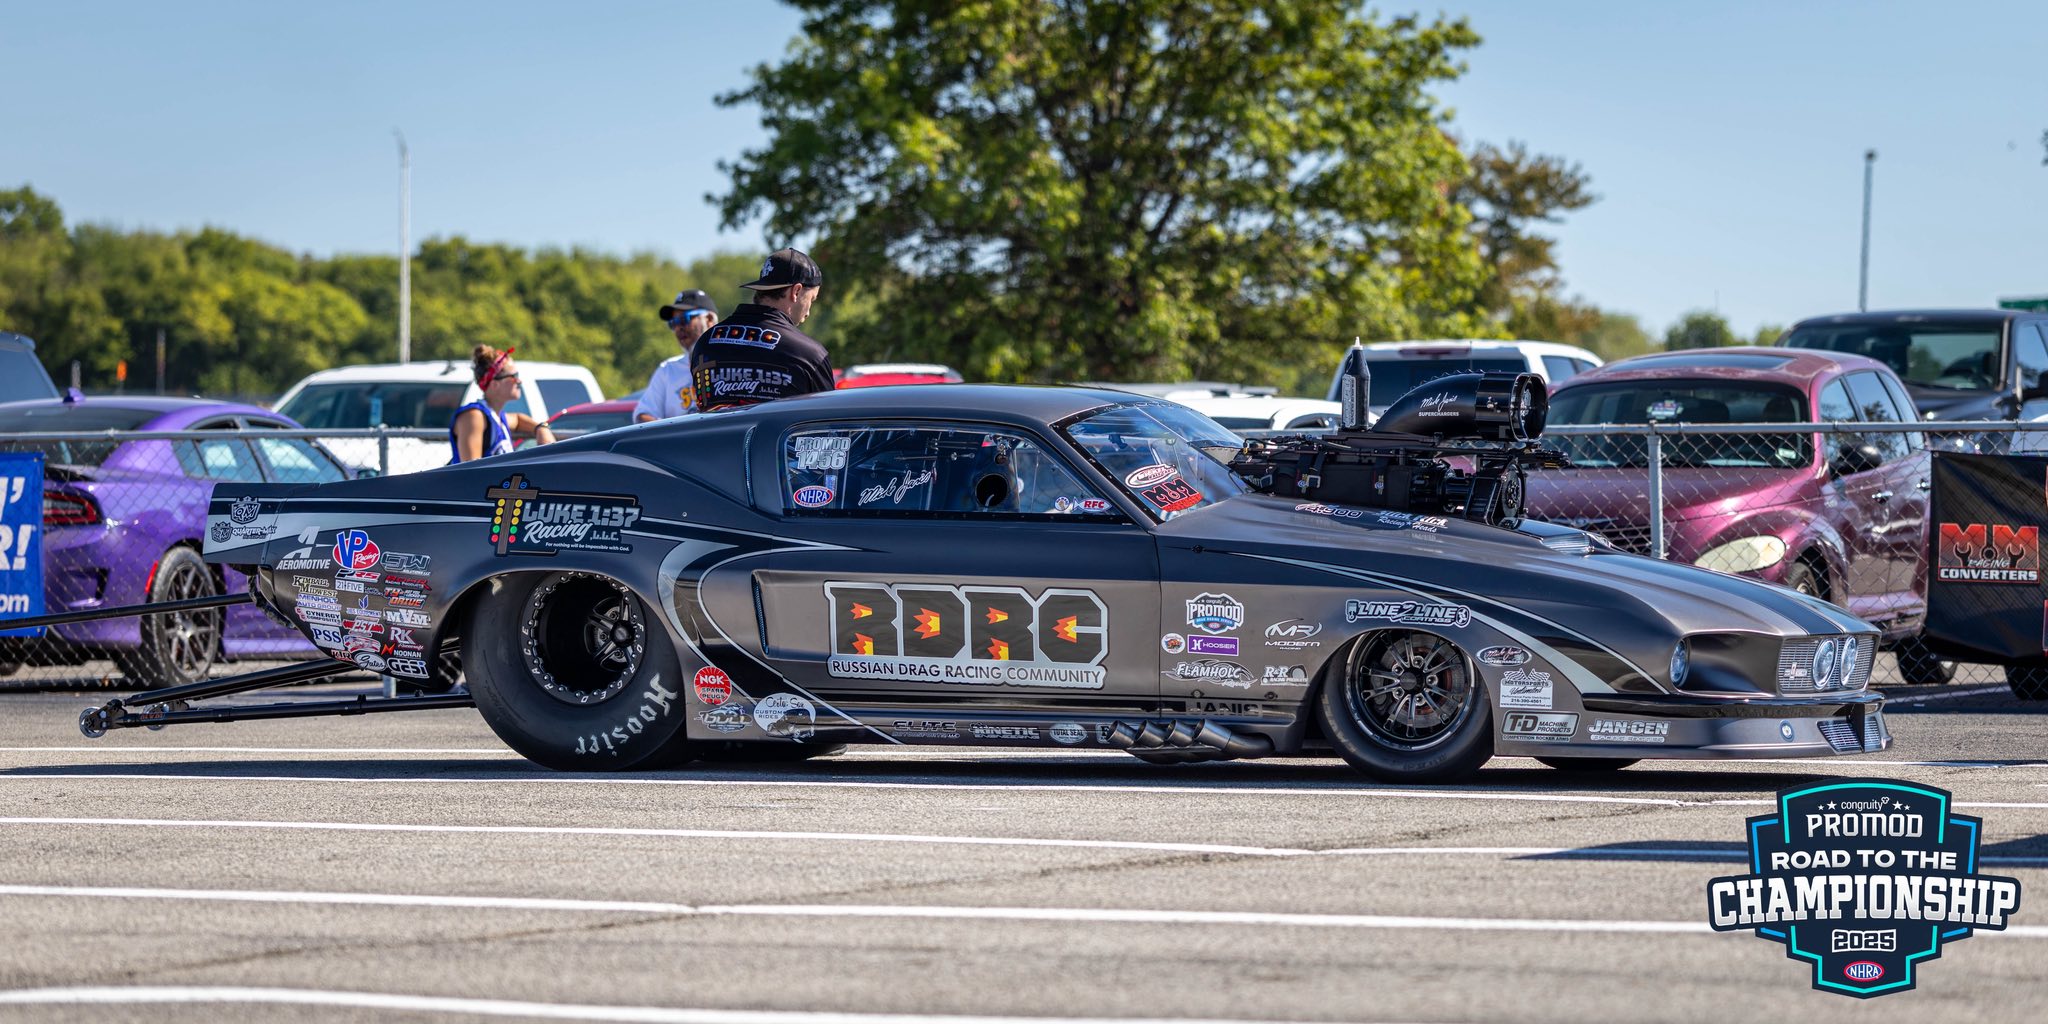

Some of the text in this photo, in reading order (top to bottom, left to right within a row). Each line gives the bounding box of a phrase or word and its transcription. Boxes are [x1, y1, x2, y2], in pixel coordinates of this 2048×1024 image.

[711, 368, 792, 387] LUKE 1:37
[713, 380, 760, 396] Racing
[795, 437, 851, 452] PROMOD
[796, 451, 846, 470] 1456
[799, 489, 829, 505] NHRA
[234, 505, 258, 519] QM
[1084, 501, 1105, 509] RFC
[522, 502, 641, 528] LUKE 1:37
[523, 521, 596, 543] Racing
[1377, 516, 1438, 533] Racing Heads
[337, 529, 379, 569] VP Racing
[276, 559, 331, 571] AEROMOTIVE
[1967, 559, 2011, 568] RACING
[293, 576, 329, 586] KIMBALL
[1940, 569, 2038, 581] CONVERTERS
[300, 584, 338, 597] MIDWEST
[298, 594, 338, 603] MENHOLT
[386, 609, 430, 626] MVM
[1189, 604, 1241, 622] PROMOD
[1357, 602, 1458, 618] LINE2LINE
[824, 582, 1108, 666] RDRC
[1402, 616, 1452, 624] COATINGS
[312, 627, 342, 644] PSS
[390, 627, 416, 645] RK
[1269, 624, 1316, 637] MR
[393, 650, 422, 658] NOONAN
[359, 655, 384, 670] Gates
[832, 660, 1101, 684] RUSSIAN DRAG RACING COMMUNITY
[1263, 666, 1289, 678] R&R
[700, 675, 725, 685] NGK
[1505, 680, 1549, 688] MOTORSPORTS
[573, 672, 678, 757] Hoosier
[892, 719, 957, 732] ELITE
